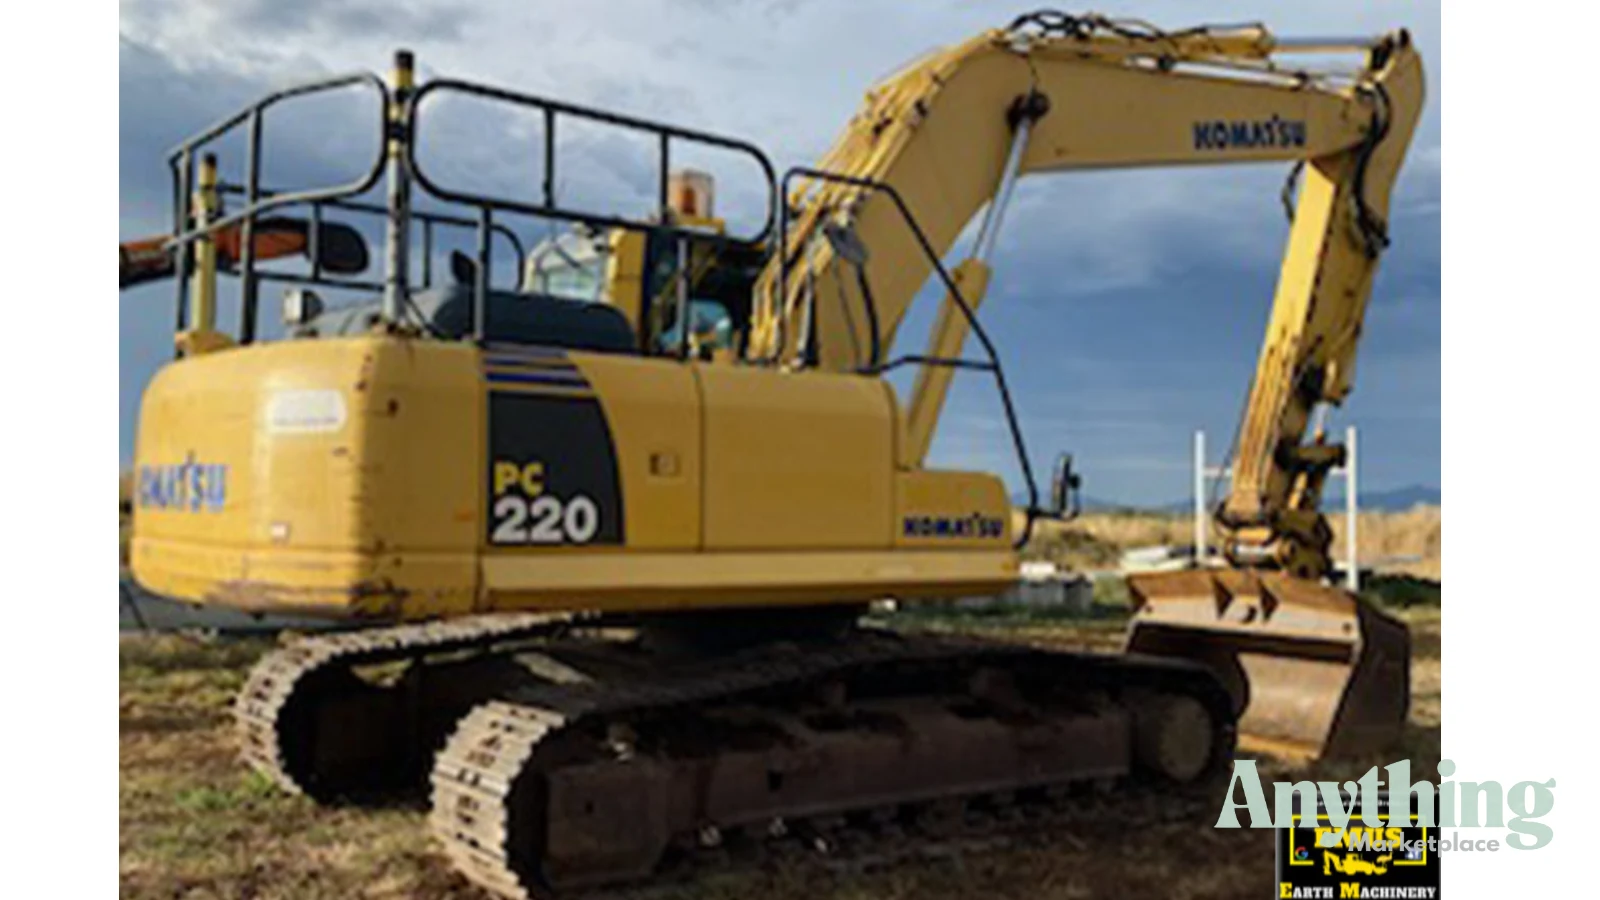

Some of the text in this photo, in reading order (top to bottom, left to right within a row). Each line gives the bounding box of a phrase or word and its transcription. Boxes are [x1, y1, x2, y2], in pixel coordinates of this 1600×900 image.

[1193, 113, 1306, 150] KOMATSU
[137, 451, 226, 513] OMATSU
[494, 461, 544, 496] PC
[492, 496, 598, 543] 220
[903, 511, 1003, 538] KOMATSU
